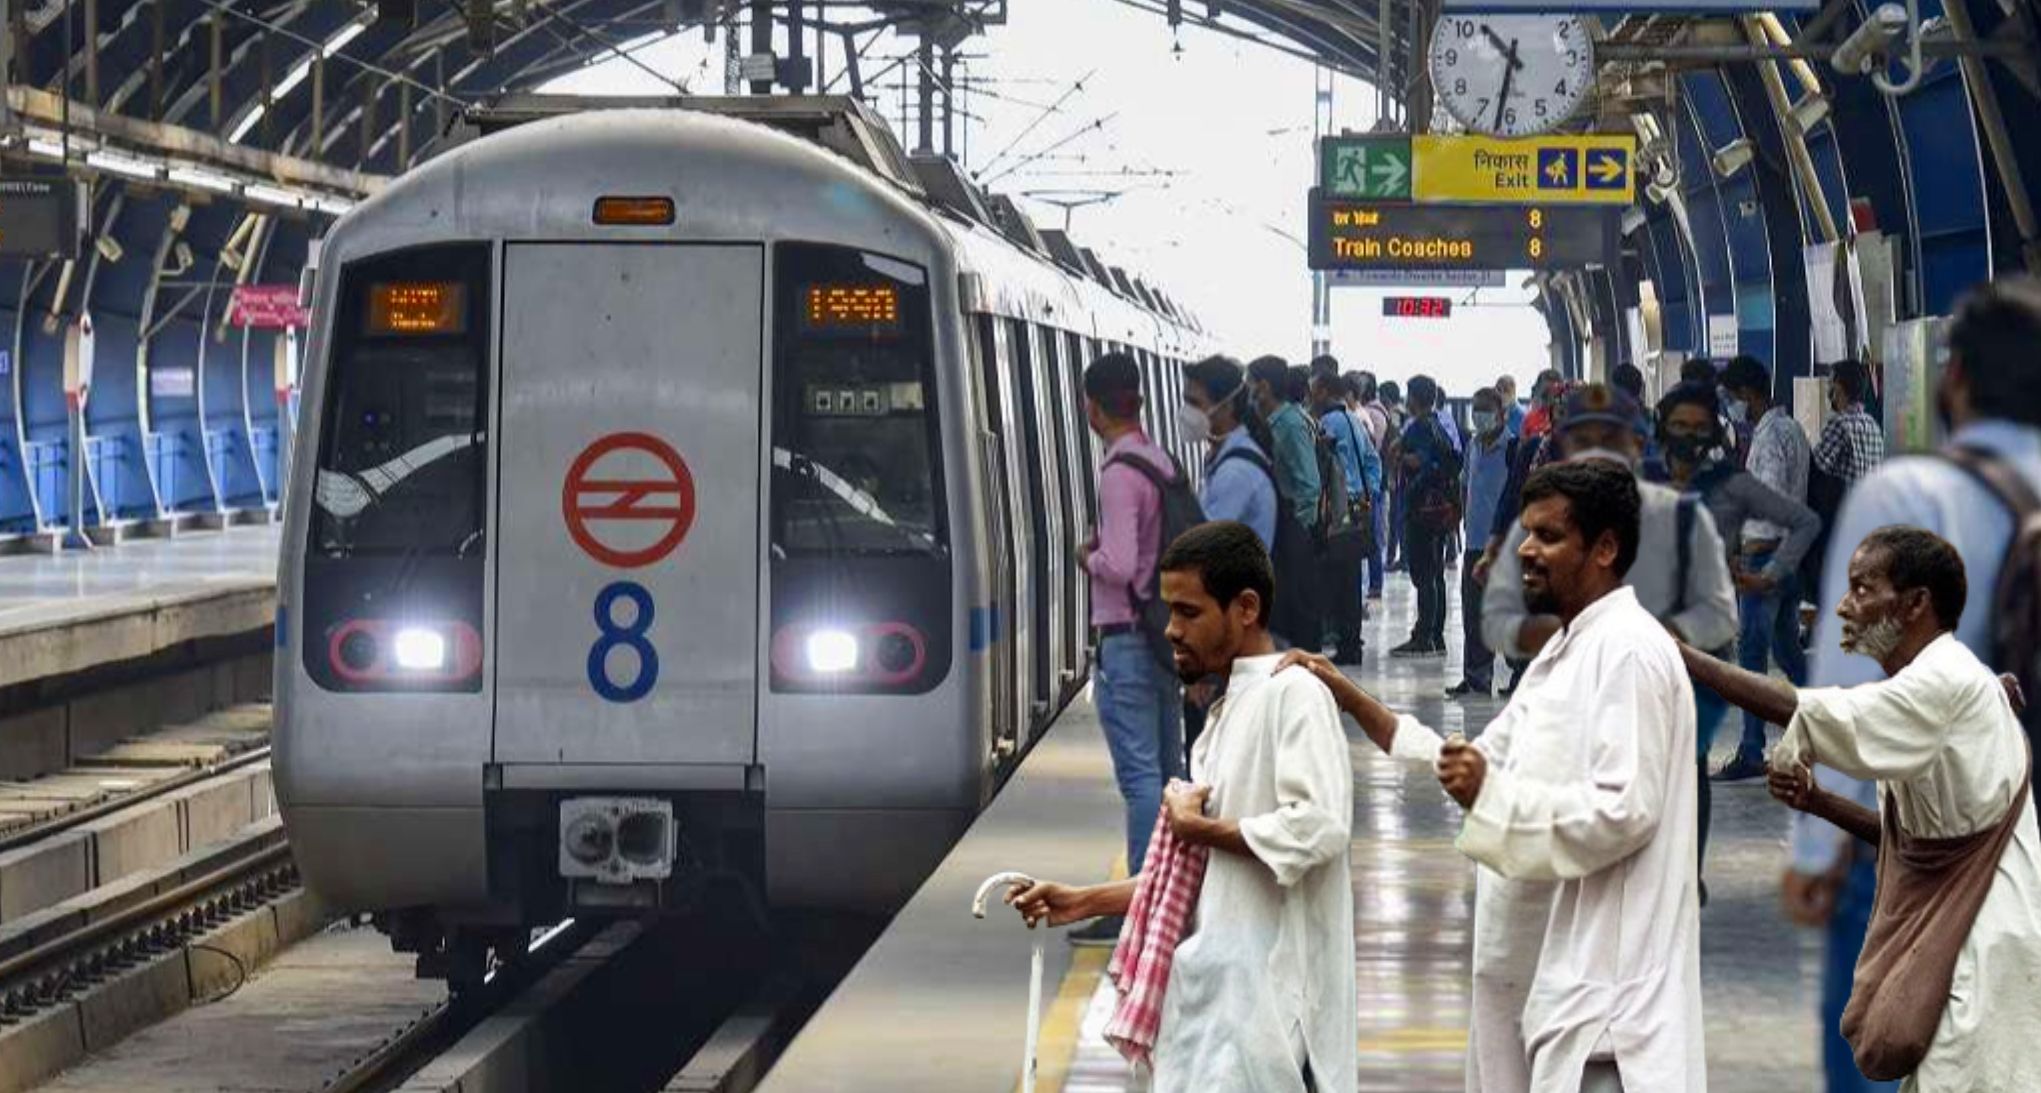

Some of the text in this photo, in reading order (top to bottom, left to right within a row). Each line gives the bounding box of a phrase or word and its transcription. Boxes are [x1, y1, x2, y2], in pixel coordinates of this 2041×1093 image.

[1455, 20, 1474, 38] 10
[1558, 21, 1569, 39] 2
[1445, 50, 1457, 66] 9
[1566, 50, 1577, 67] 3
[1455, 78, 1466, 95] 8
[1555, 78, 1566, 96] 4
[1477, 99, 1490, 116] 7
[1535, 99, 1546, 116] 5
[1505, 108, 1516, 125] 6
[1474, 148, 1530, 172] निकास
[1495, 172, 1530, 188] Exit
[1529, 209, 1541, 228] 8
[1334, 238, 1541, 257] Train Coaches 8
[587, 581, 660, 703] 8
